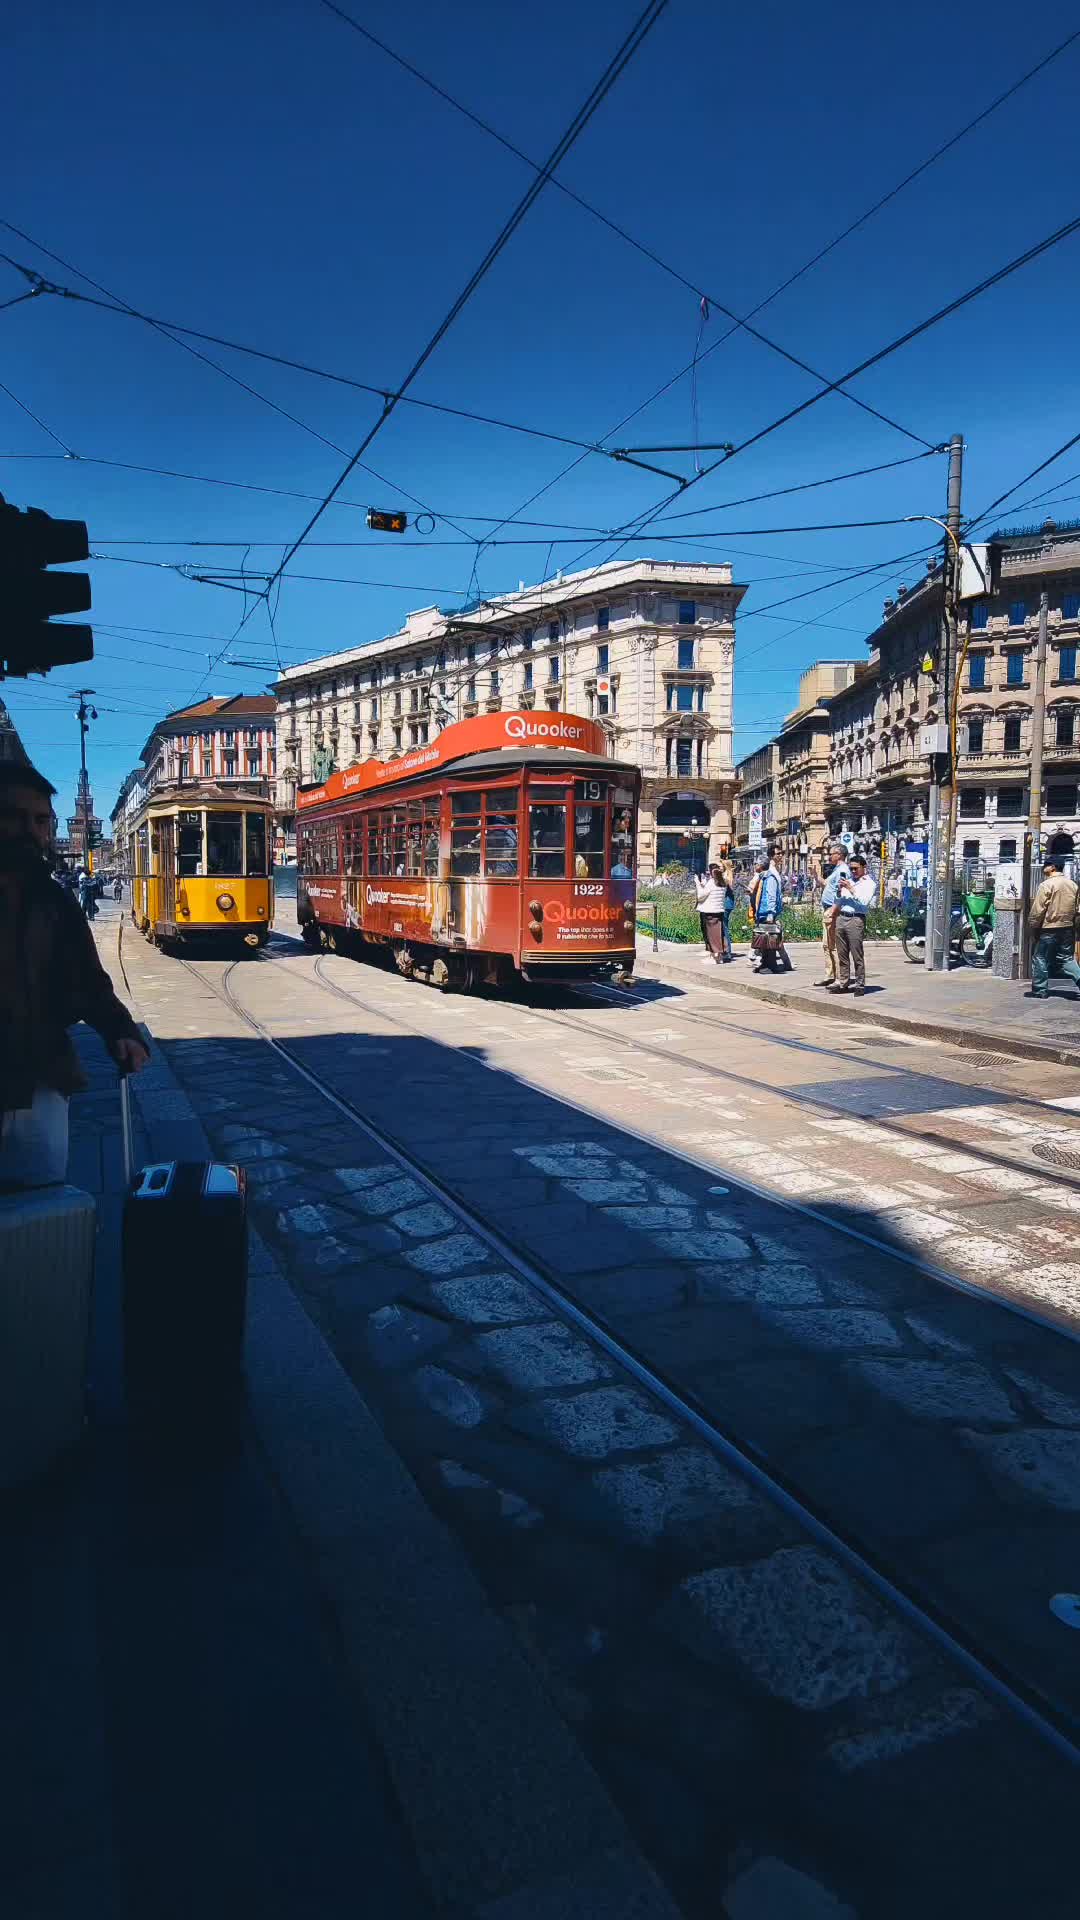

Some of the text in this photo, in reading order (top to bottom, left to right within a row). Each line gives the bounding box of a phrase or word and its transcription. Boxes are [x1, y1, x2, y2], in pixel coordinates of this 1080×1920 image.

[504, 716, 581, 739] Quooker
[583, 781, 601, 800] 19
[186, 811, 199, 823] 19
[366, 884, 391, 906] Quooker
[574, 884, 604, 896] 1922
[543, 901, 623, 925] Quooker
